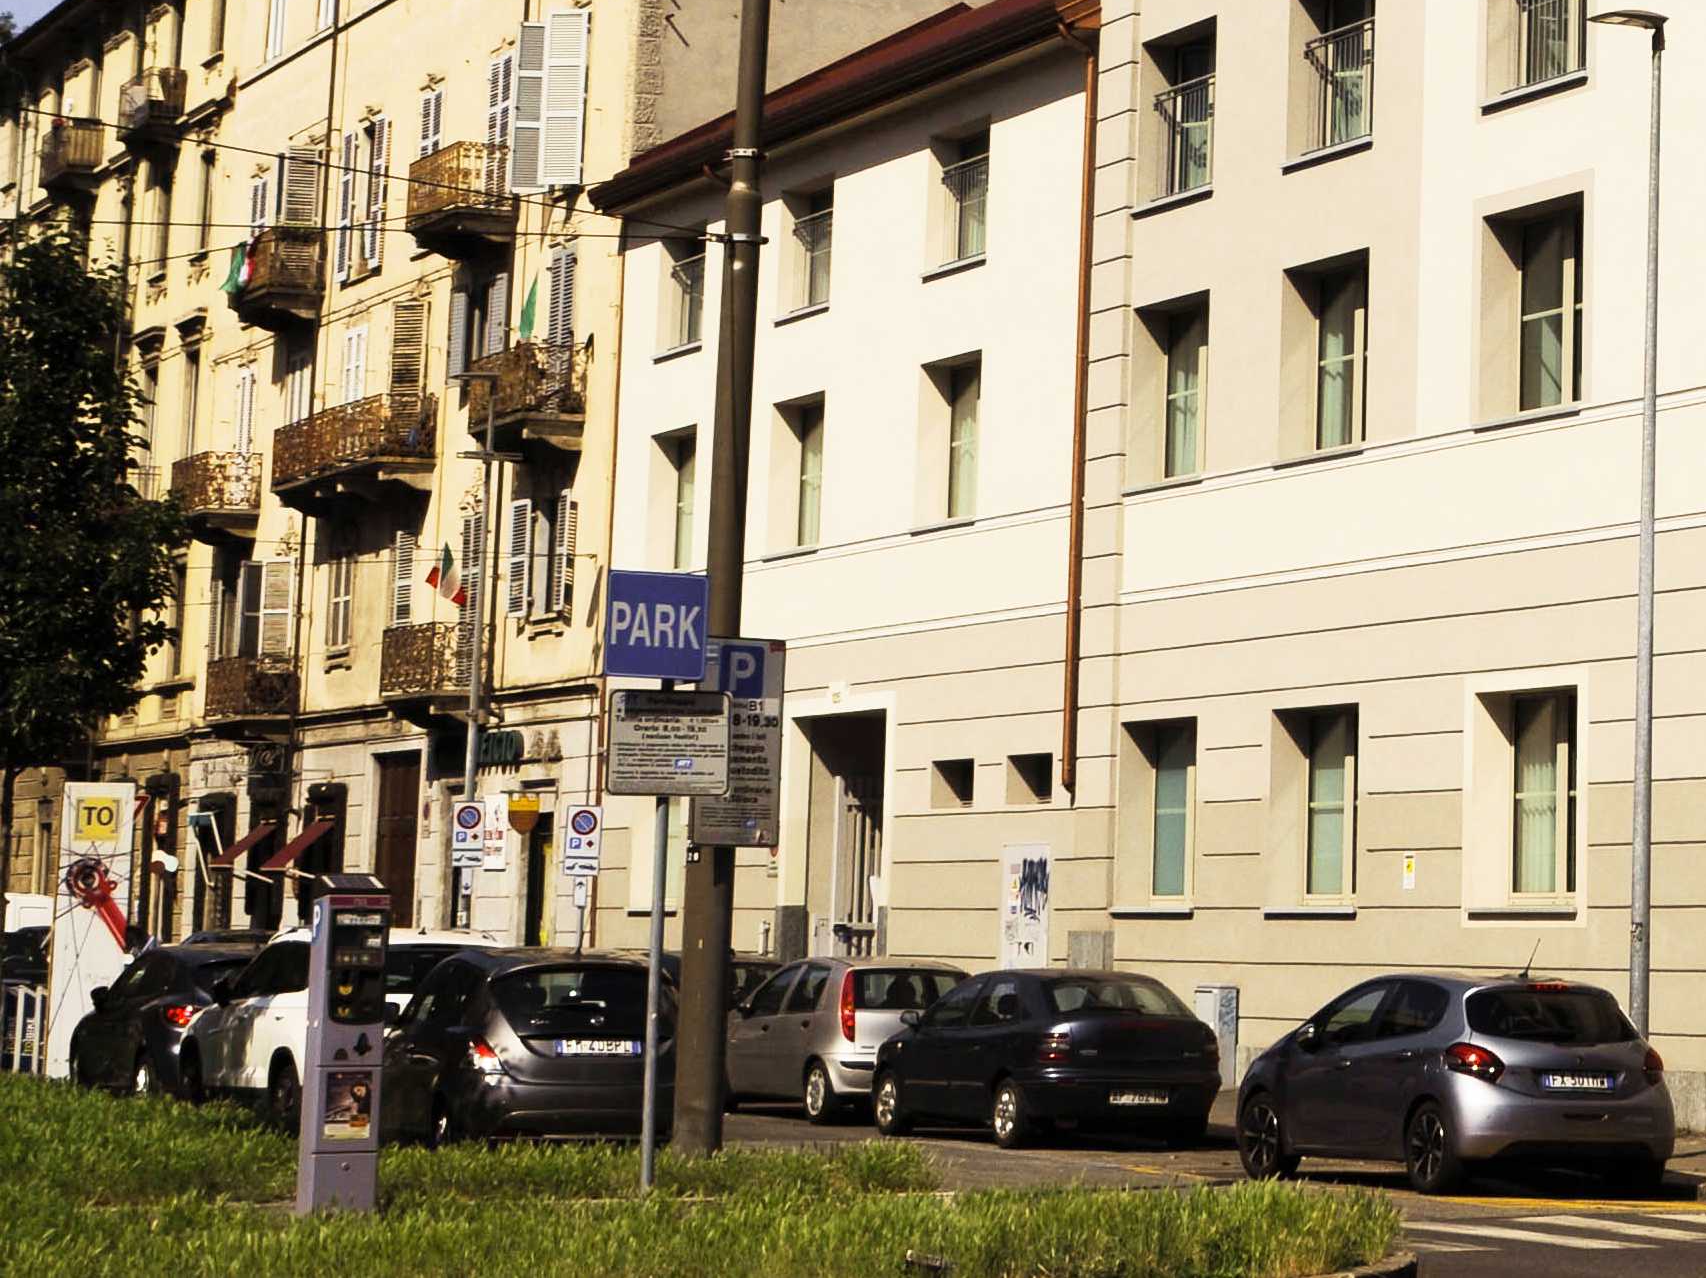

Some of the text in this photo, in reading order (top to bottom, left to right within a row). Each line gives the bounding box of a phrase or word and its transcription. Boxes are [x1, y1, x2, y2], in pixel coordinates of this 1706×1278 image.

[610, 600, 700, 650] PARK
[729, 651, 756, 692] P
[748, 700, 763, 712] B1
[83, 806, 114, 826] TO
